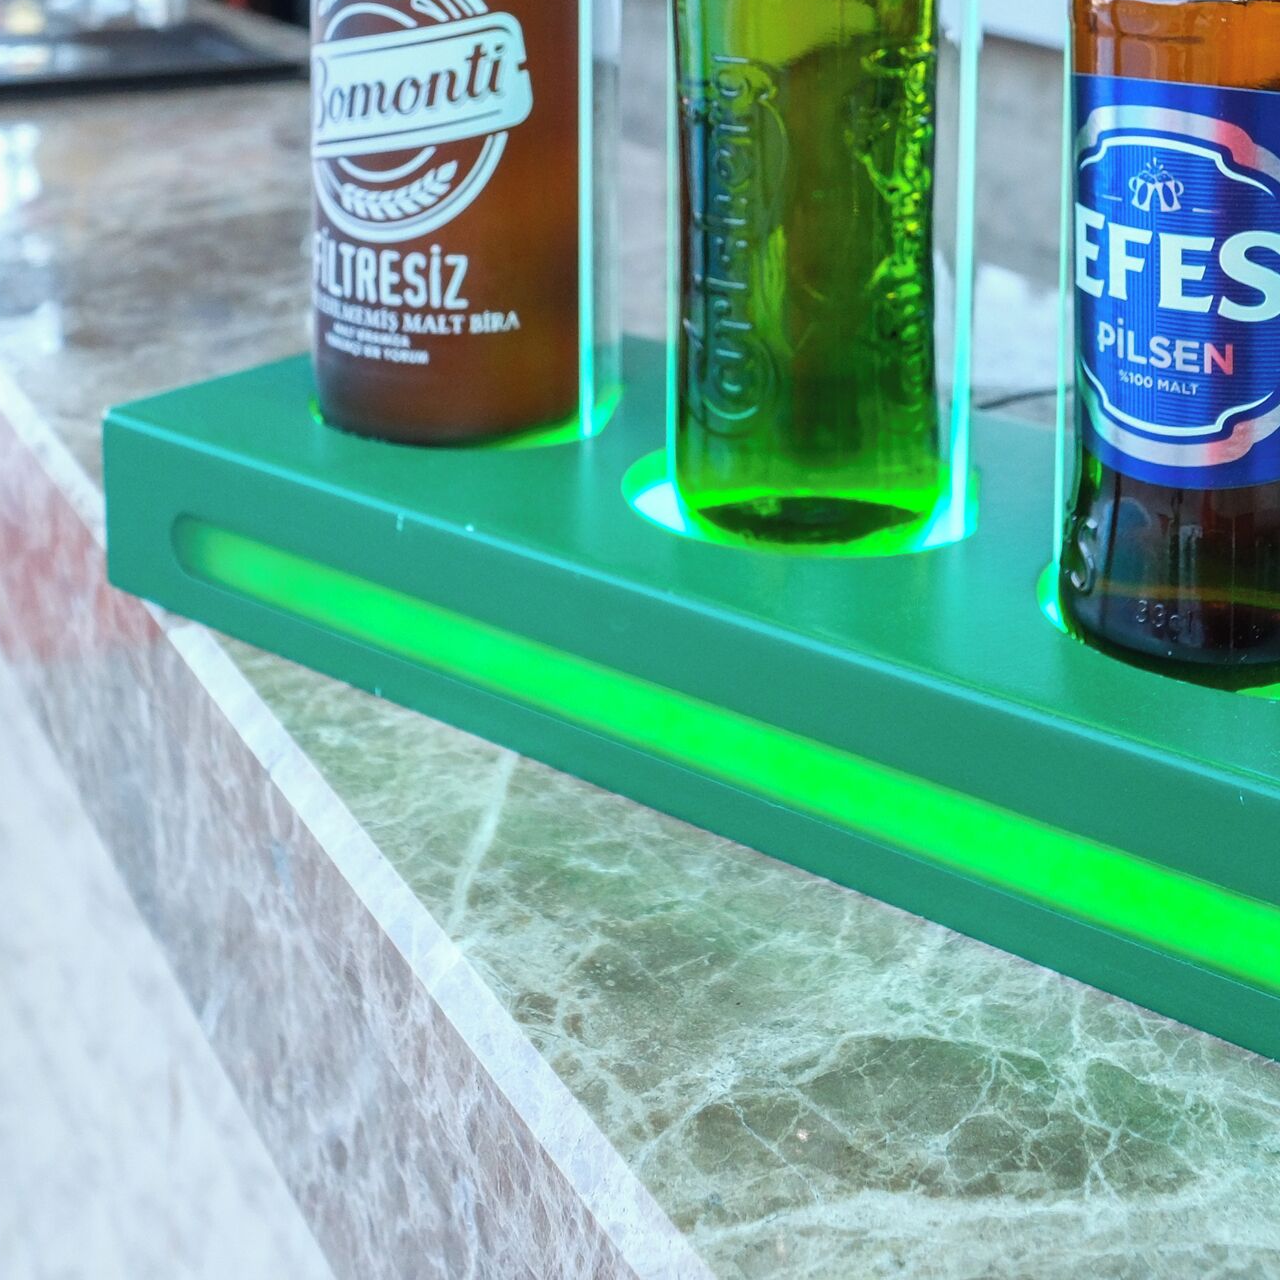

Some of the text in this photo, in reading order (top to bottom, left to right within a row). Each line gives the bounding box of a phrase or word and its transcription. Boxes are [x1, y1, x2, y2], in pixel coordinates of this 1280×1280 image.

[402, 313, 465, 335] MALT
[470, 309, 520, 334] BİRA
[1097, 317, 1234, 376] PİLSEN
[1119, 369, 1199, 397] %100 MALT
